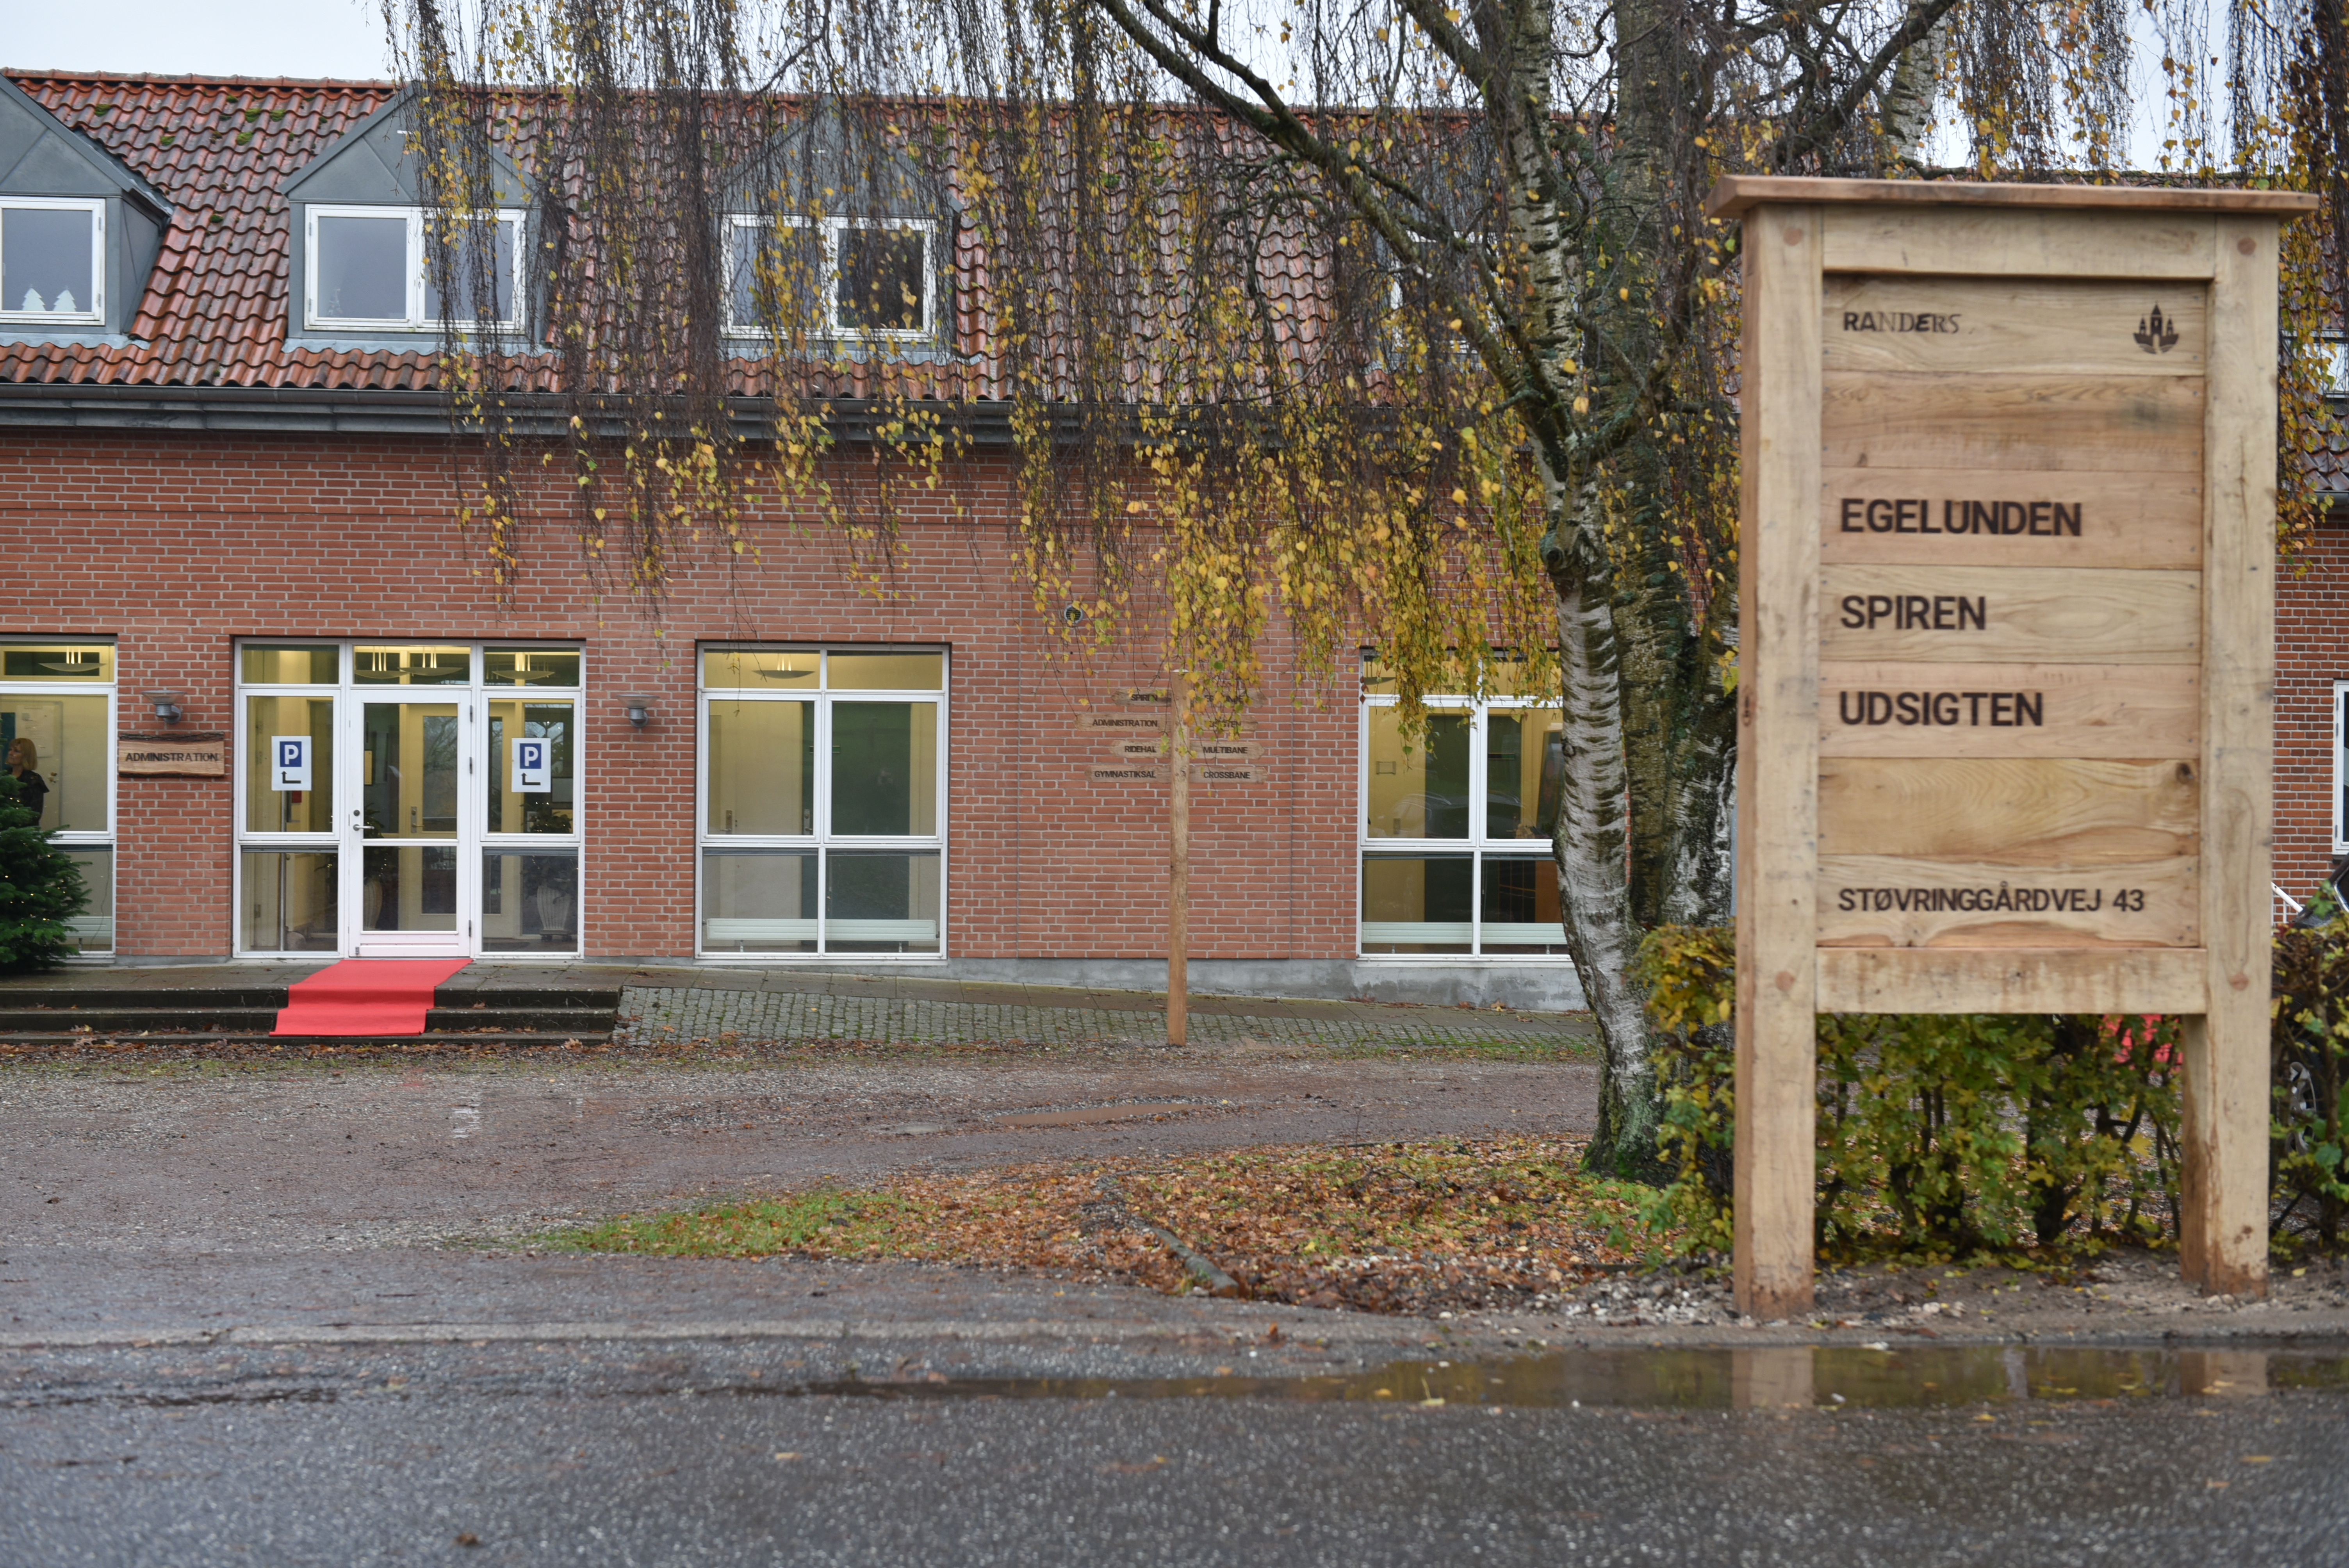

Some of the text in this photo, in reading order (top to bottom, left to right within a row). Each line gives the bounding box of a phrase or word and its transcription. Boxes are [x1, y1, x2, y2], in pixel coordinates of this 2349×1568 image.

[1843, 310, 1962, 334] RANDERS
[1840, 497, 2082, 536] EGELUNDEN
[1840, 595, 1986, 630] SPIREN
[1839, 691, 2043, 726] UDSIGTEN
[125, 752, 219, 762] ADMINISTRATION
[284, 745, 299, 765] P
[524, 747, 539, 766] P
[1838, 881, 2144, 912] STØVRINGGÅRDVEJ 43
